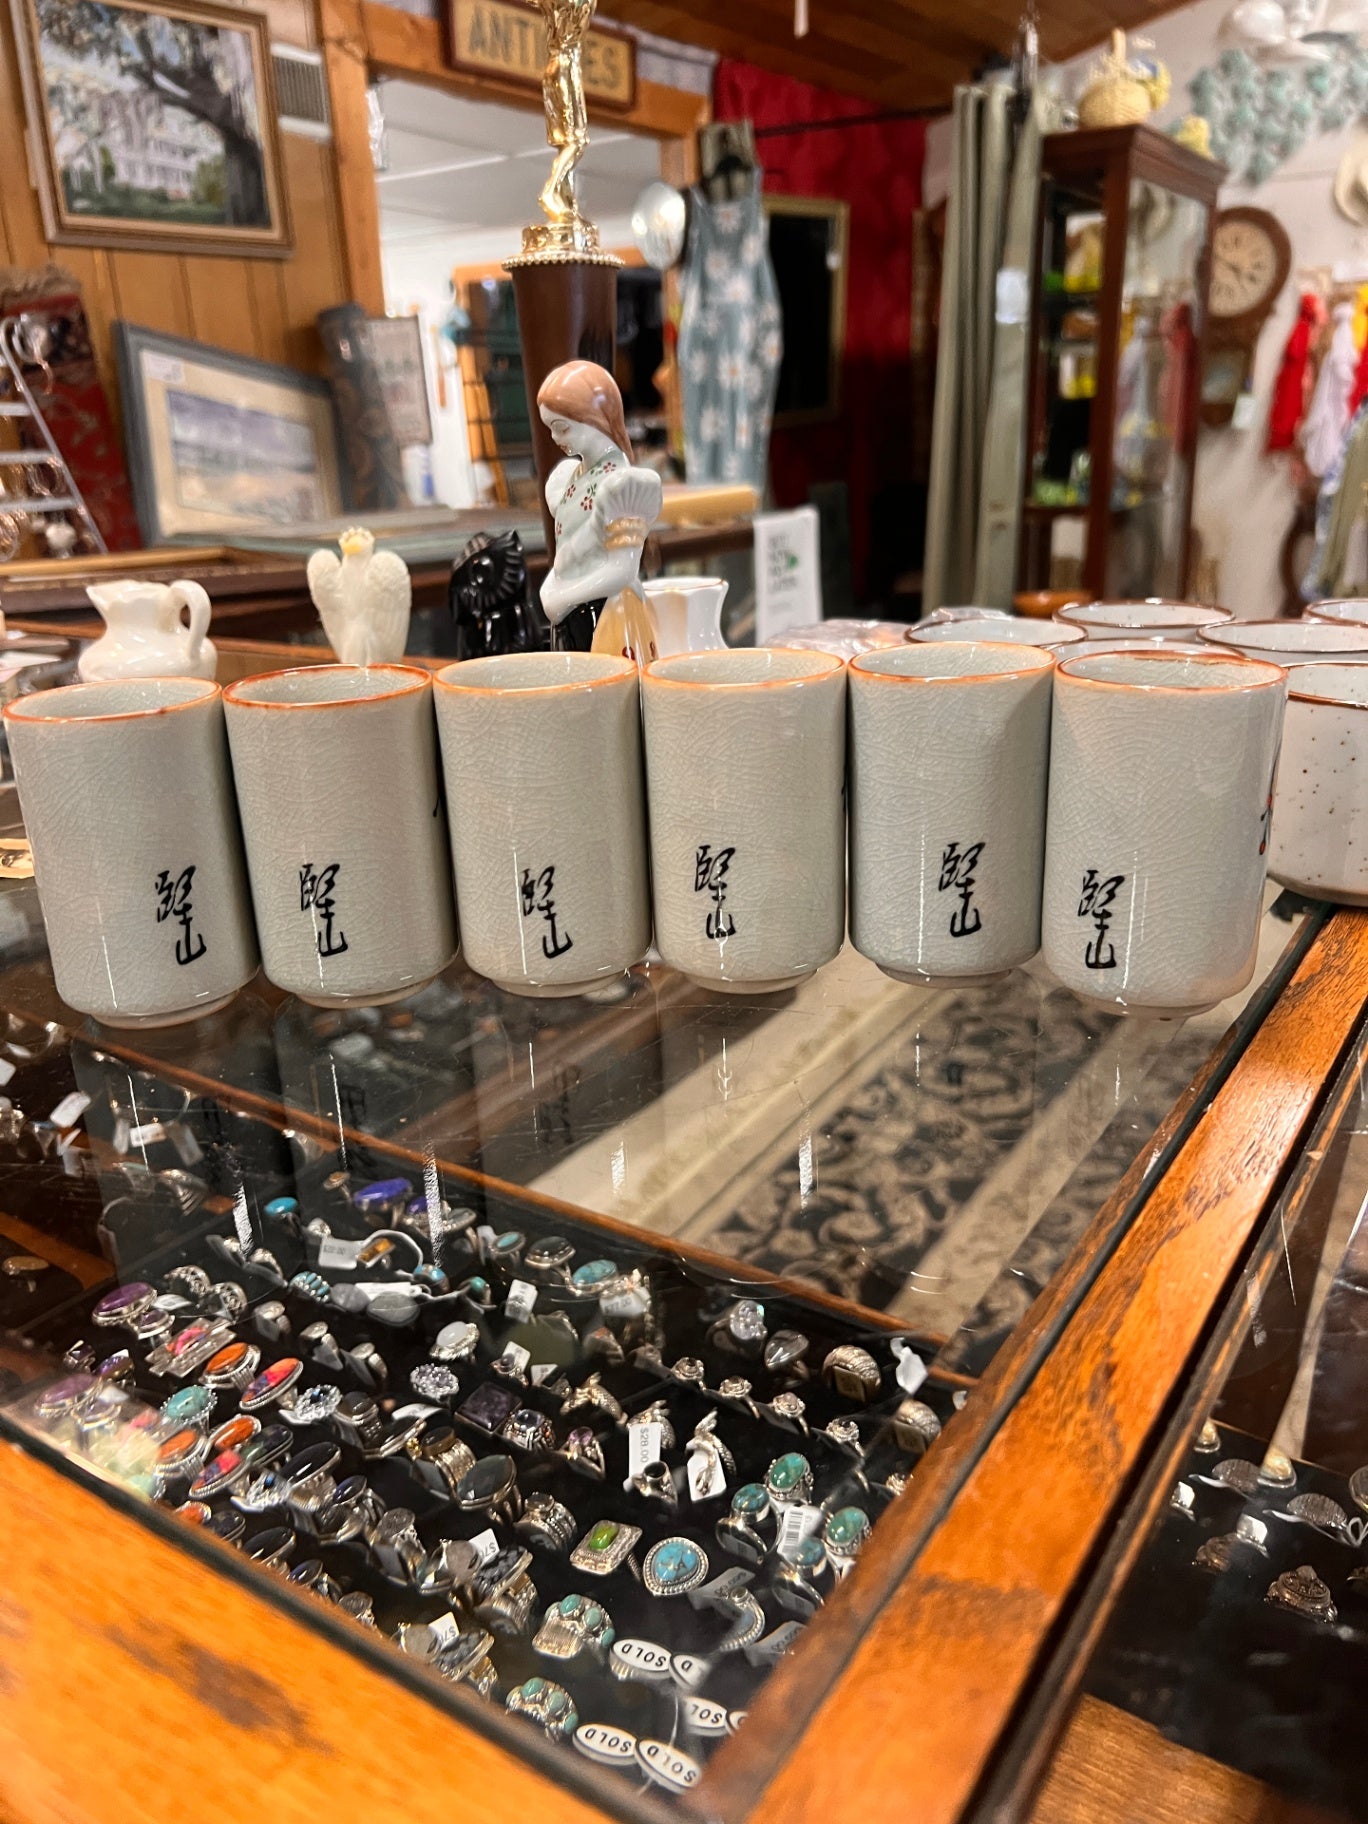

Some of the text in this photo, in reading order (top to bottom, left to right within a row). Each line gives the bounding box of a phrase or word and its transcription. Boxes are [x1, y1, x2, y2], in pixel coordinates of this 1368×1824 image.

[469, 7, 621, 90] ANTIES
[639, 1427, 649, 1463] $28.00
[621, 1643, 667, 1668] SOLD
[584, 1728, 632, 1753] SOLD
[646, 1745, 697, 1784] SOLD
